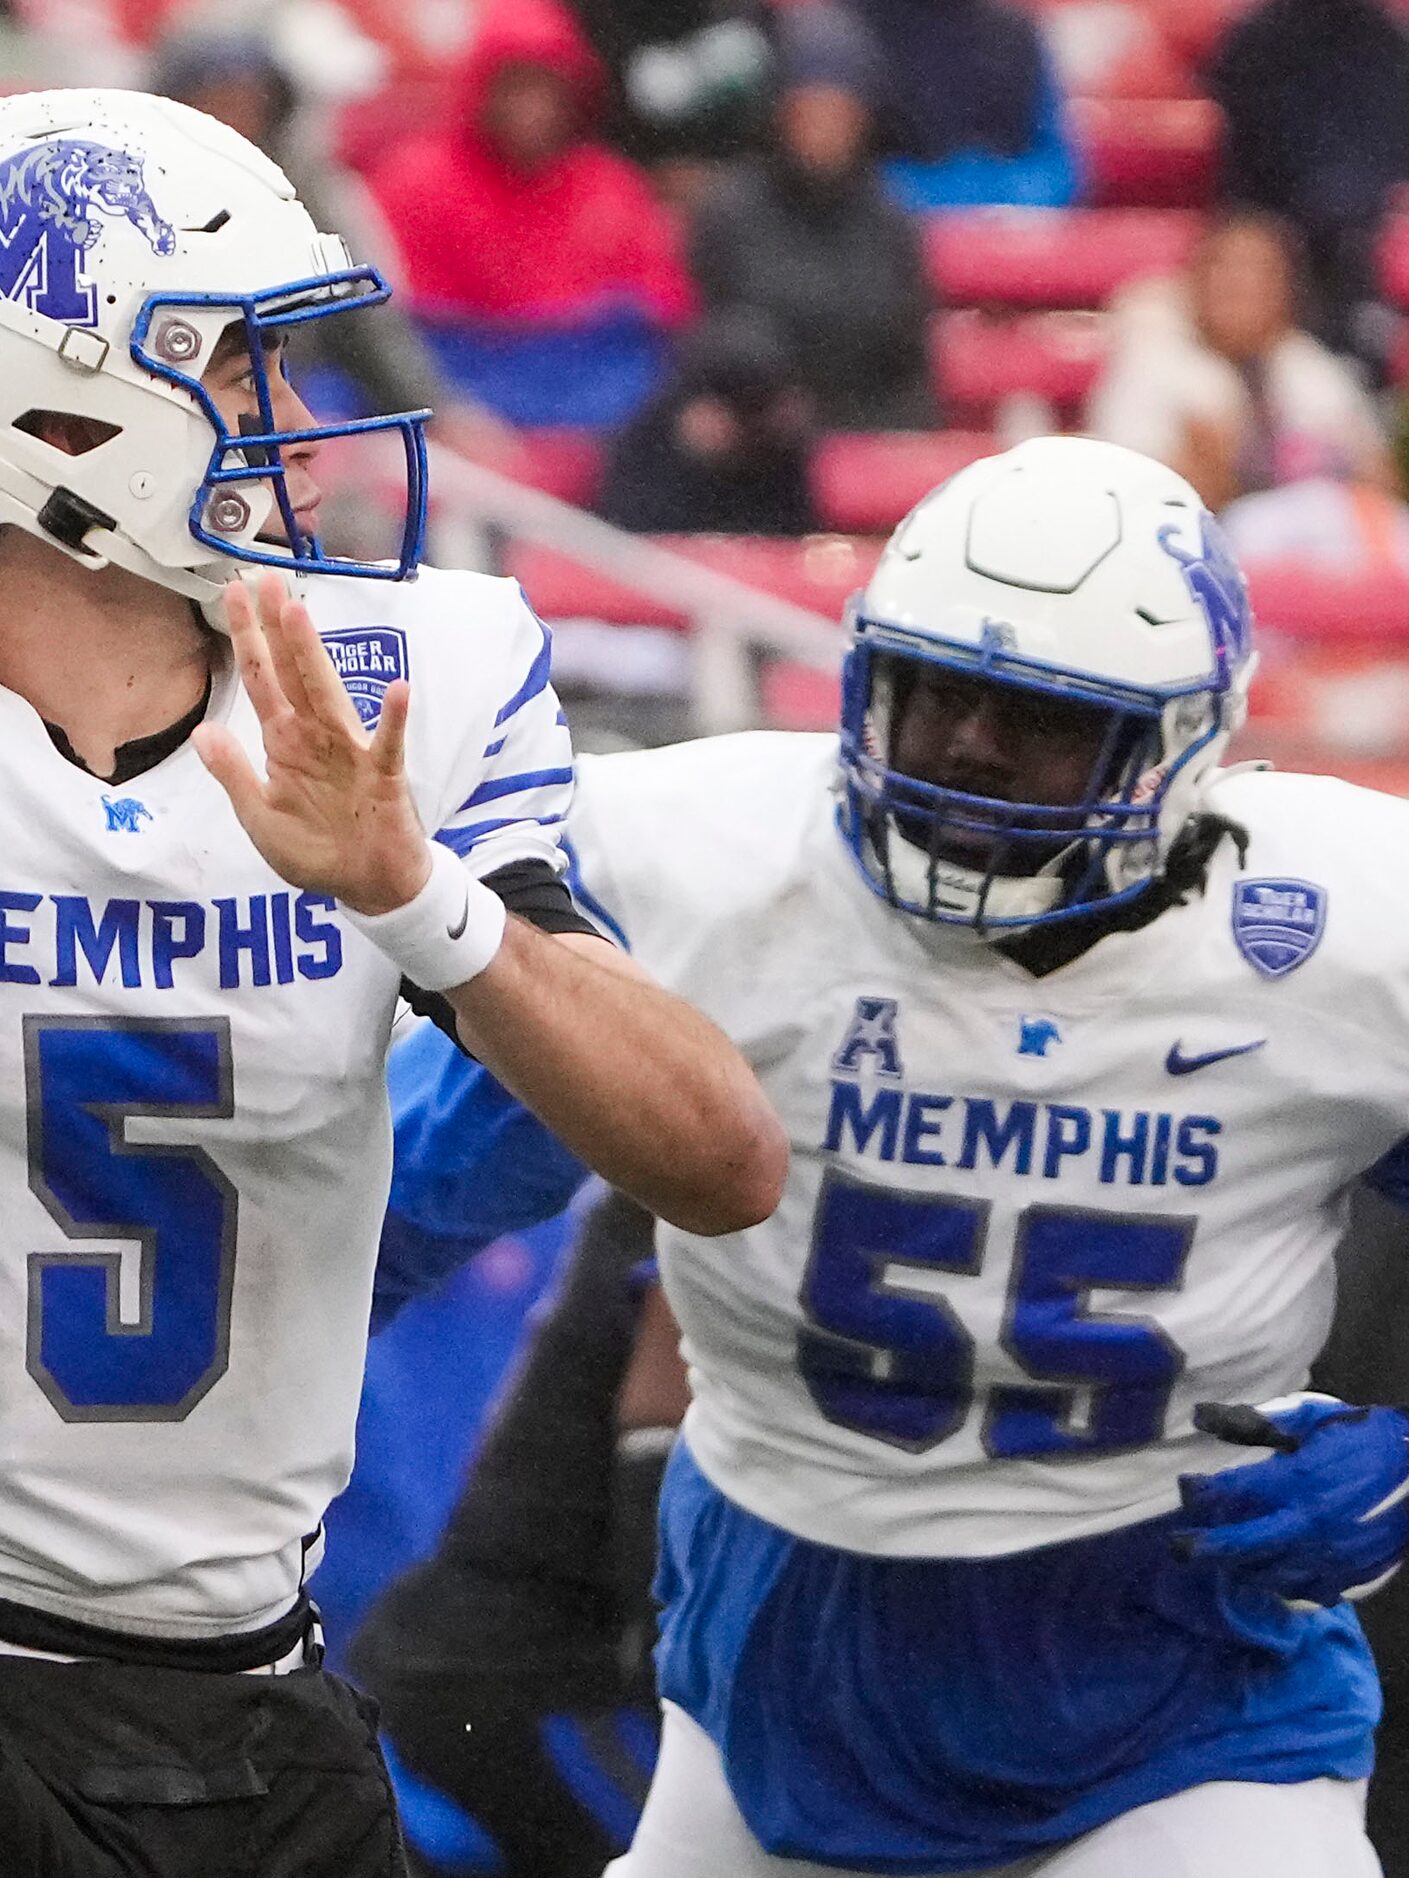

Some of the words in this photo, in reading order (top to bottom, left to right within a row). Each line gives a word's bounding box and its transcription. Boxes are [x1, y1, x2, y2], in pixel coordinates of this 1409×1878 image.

[323, 640, 383, 659] TIGER
[335, 655, 397, 673] HOLAR
[823, 1078, 1222, 1188] MEMPHIS
[22, 1013, 239, 1424] 5
[796, 1166, 1199, 1460] 55
